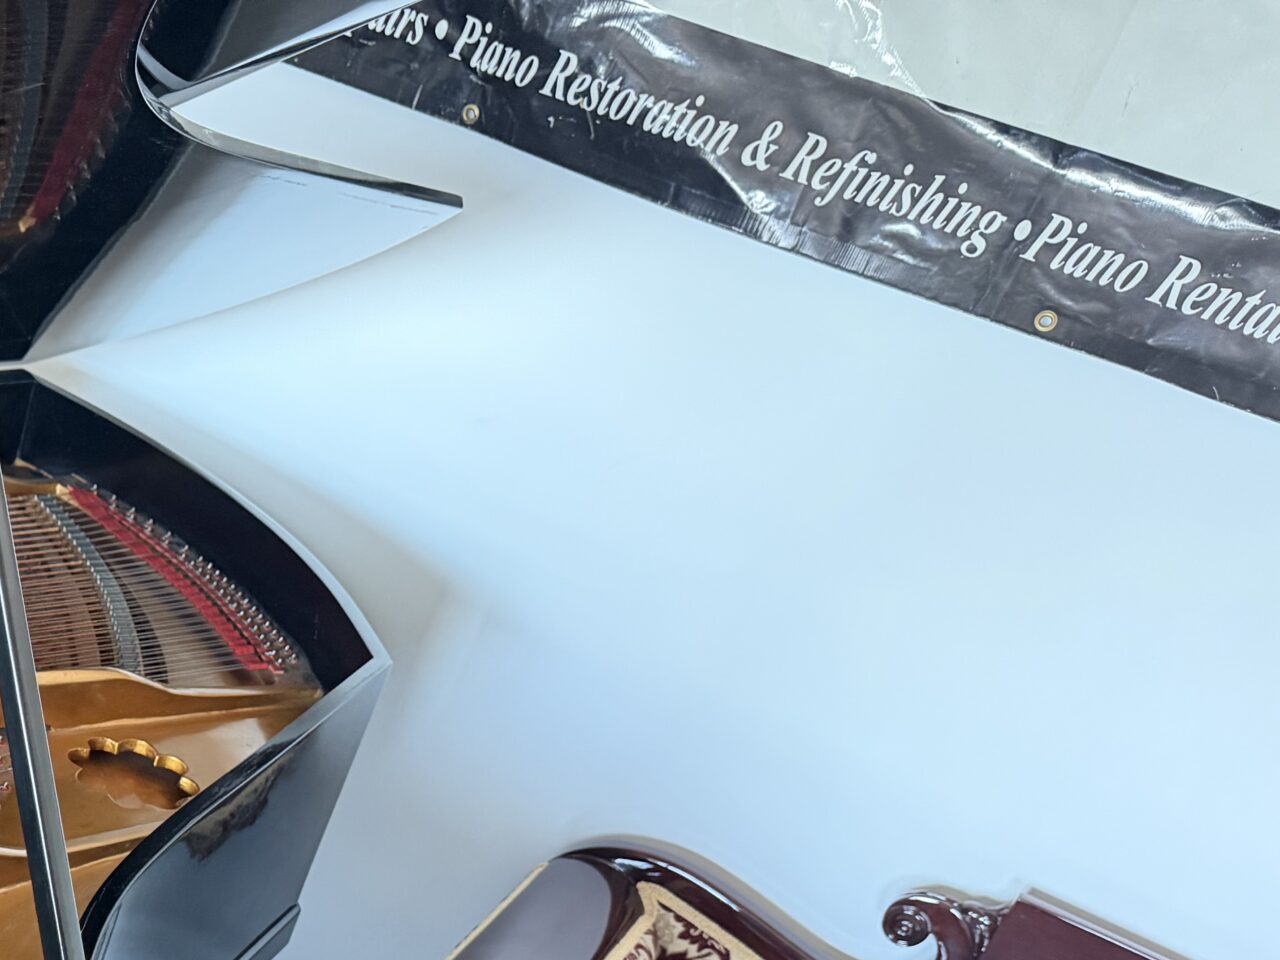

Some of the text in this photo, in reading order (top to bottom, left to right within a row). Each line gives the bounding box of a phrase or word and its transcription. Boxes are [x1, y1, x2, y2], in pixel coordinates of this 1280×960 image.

[449, 14, 538, 88] Piano
[539, 49, 740, 156] Restoration
[741, 120, 784, 171] &
[779, 132, 1007, 258] Refinishing
[1019, 213, 1149, 293] Piano
